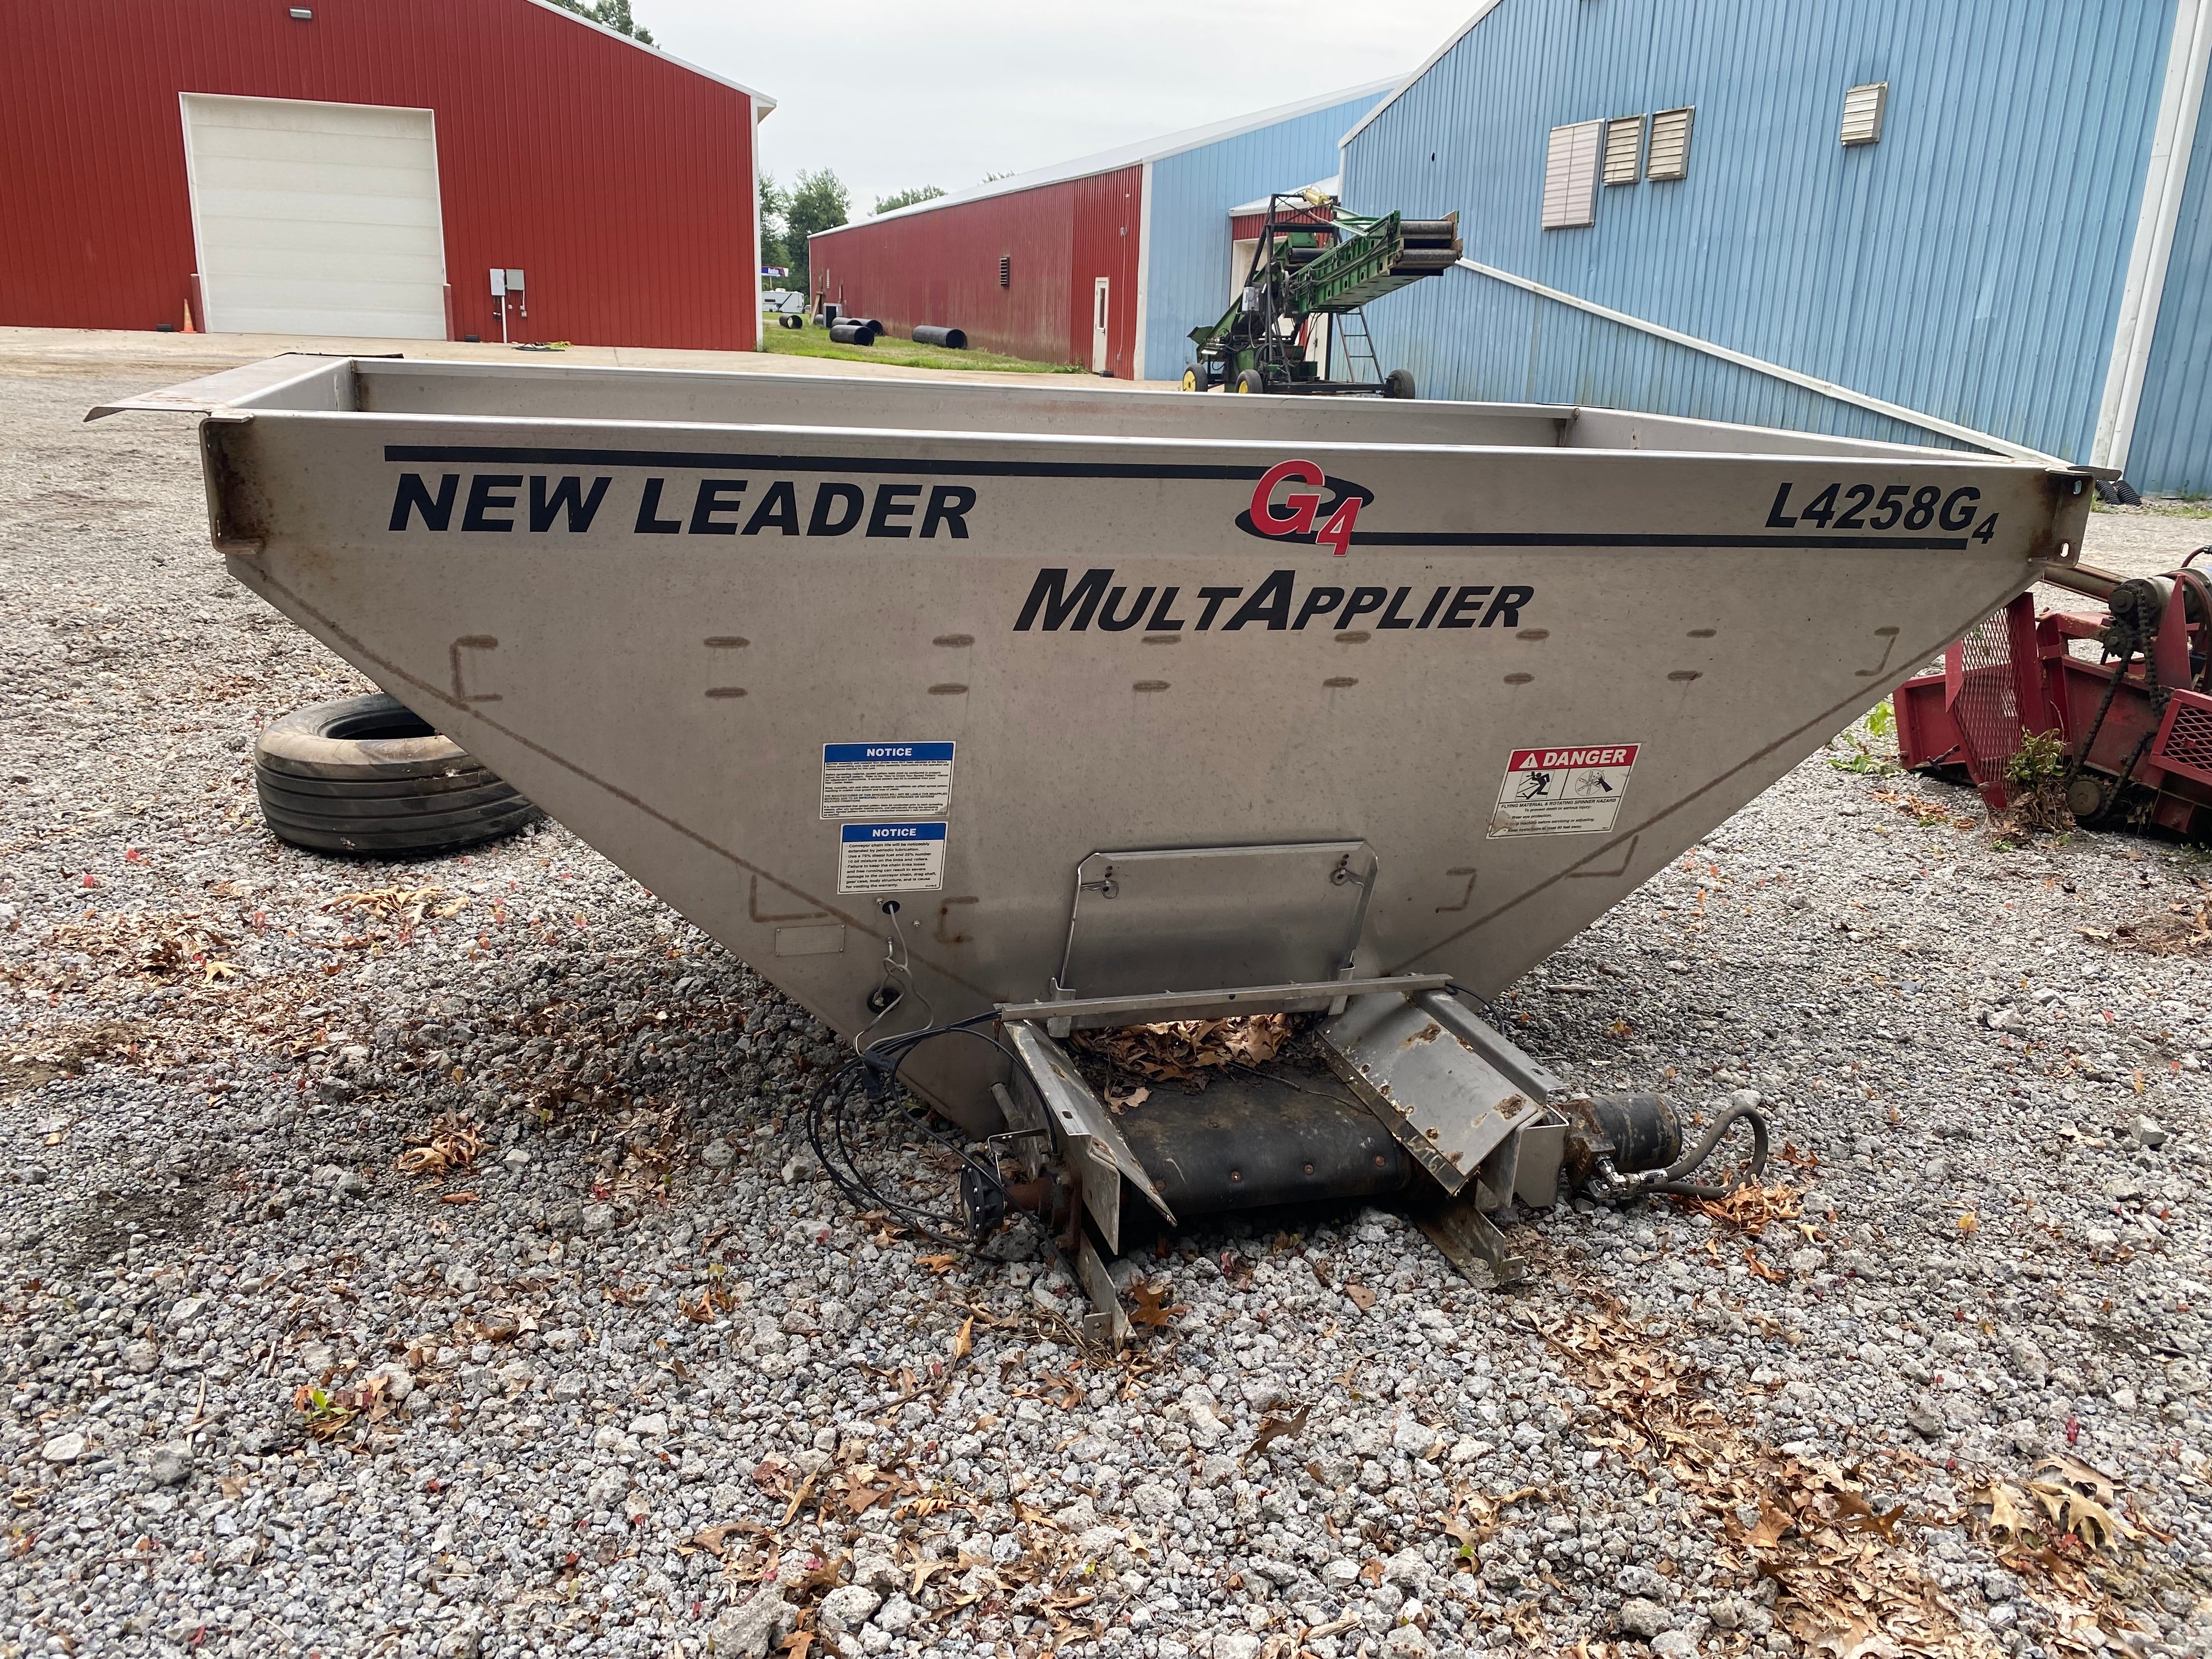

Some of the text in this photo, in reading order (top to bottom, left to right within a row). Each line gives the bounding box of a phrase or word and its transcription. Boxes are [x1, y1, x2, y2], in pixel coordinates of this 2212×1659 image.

[388, 474, 977, 539] NEW LEADER
[1765, 482, 2000, 544] L4258G4
[866, 748, 912, 757] NOTICE
[1542, 749, 1627, 766] DANGER
[872, 828, 916, 837] NOTICE
